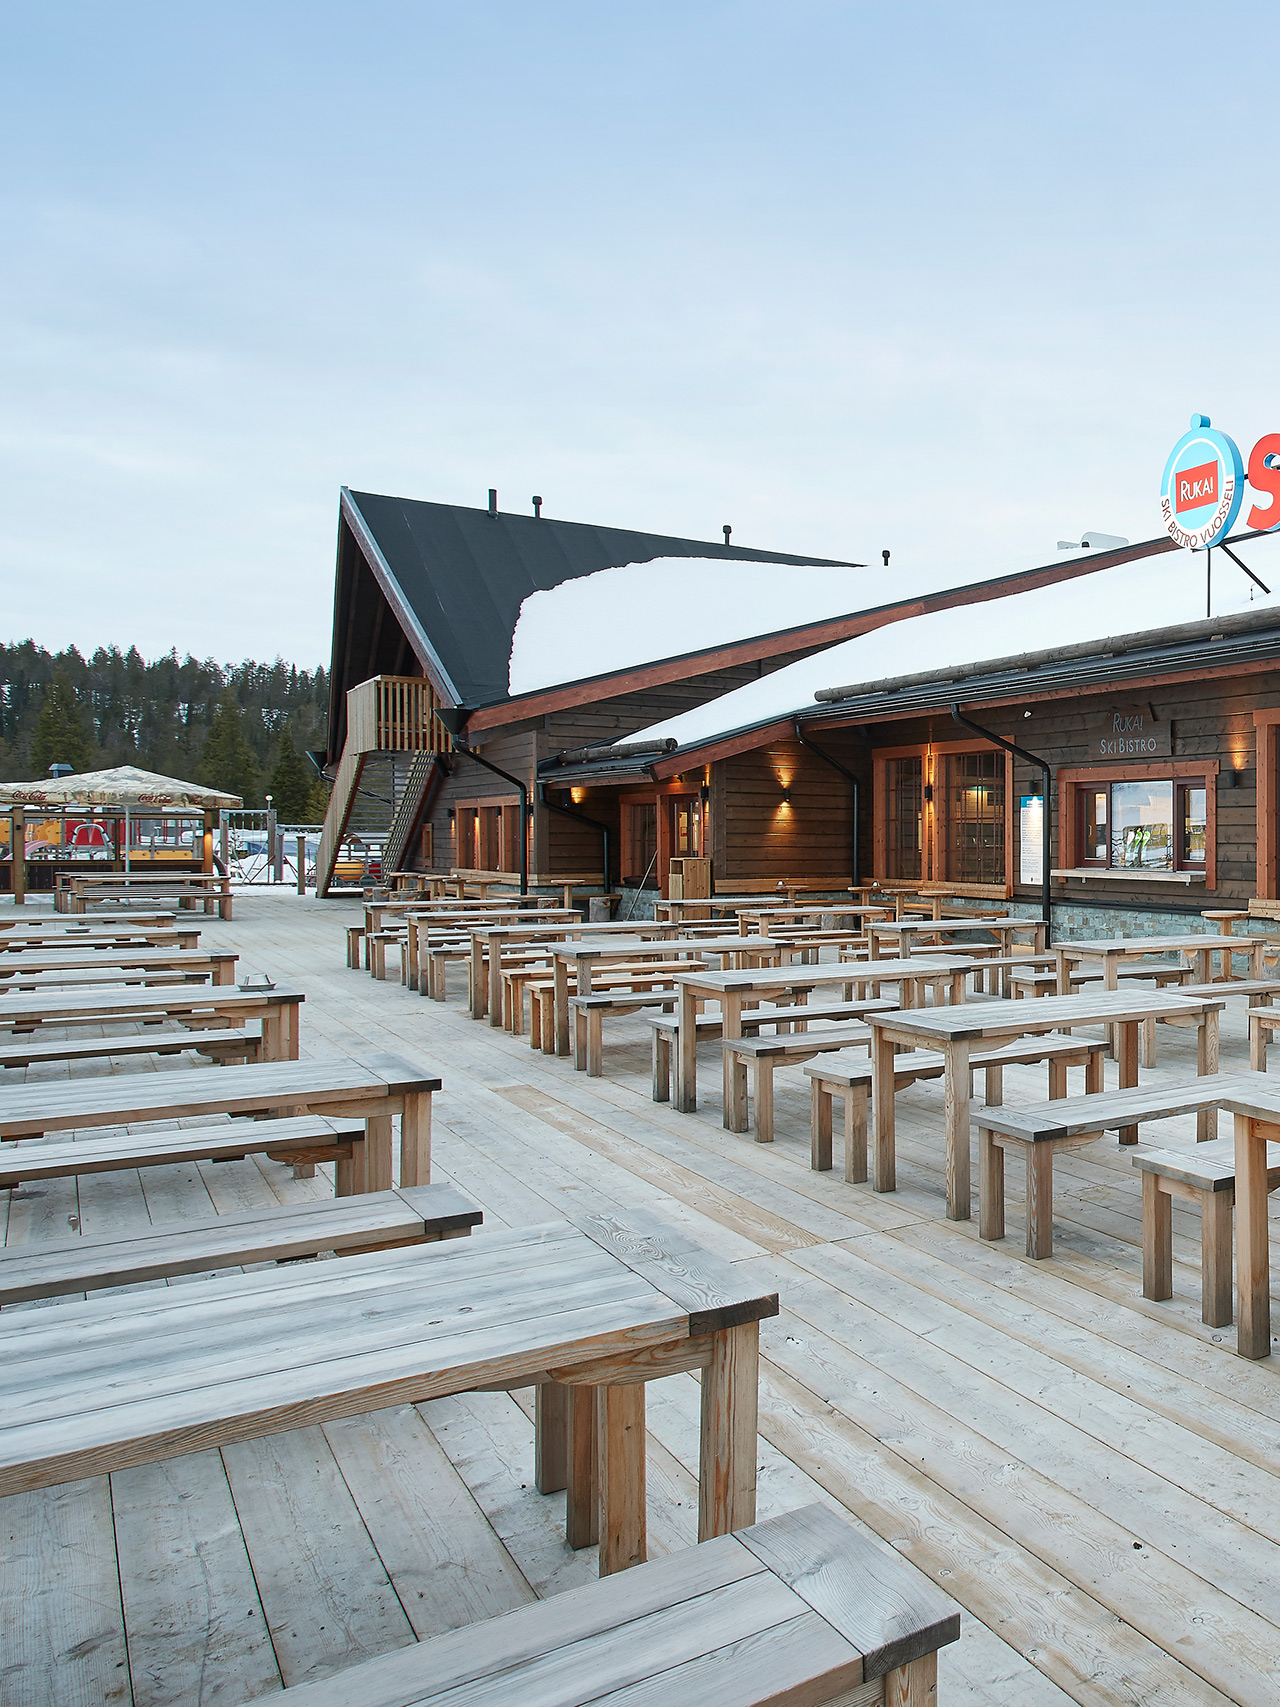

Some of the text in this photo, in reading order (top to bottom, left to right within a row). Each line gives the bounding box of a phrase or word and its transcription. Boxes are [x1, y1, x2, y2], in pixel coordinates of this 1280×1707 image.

[1180, 477, 1214, 502] RUKA!
[1161, 480, 1234, 548] SKI BISTRO VUOSSELI
[1112, 712, 1144, 733] RUKA!
